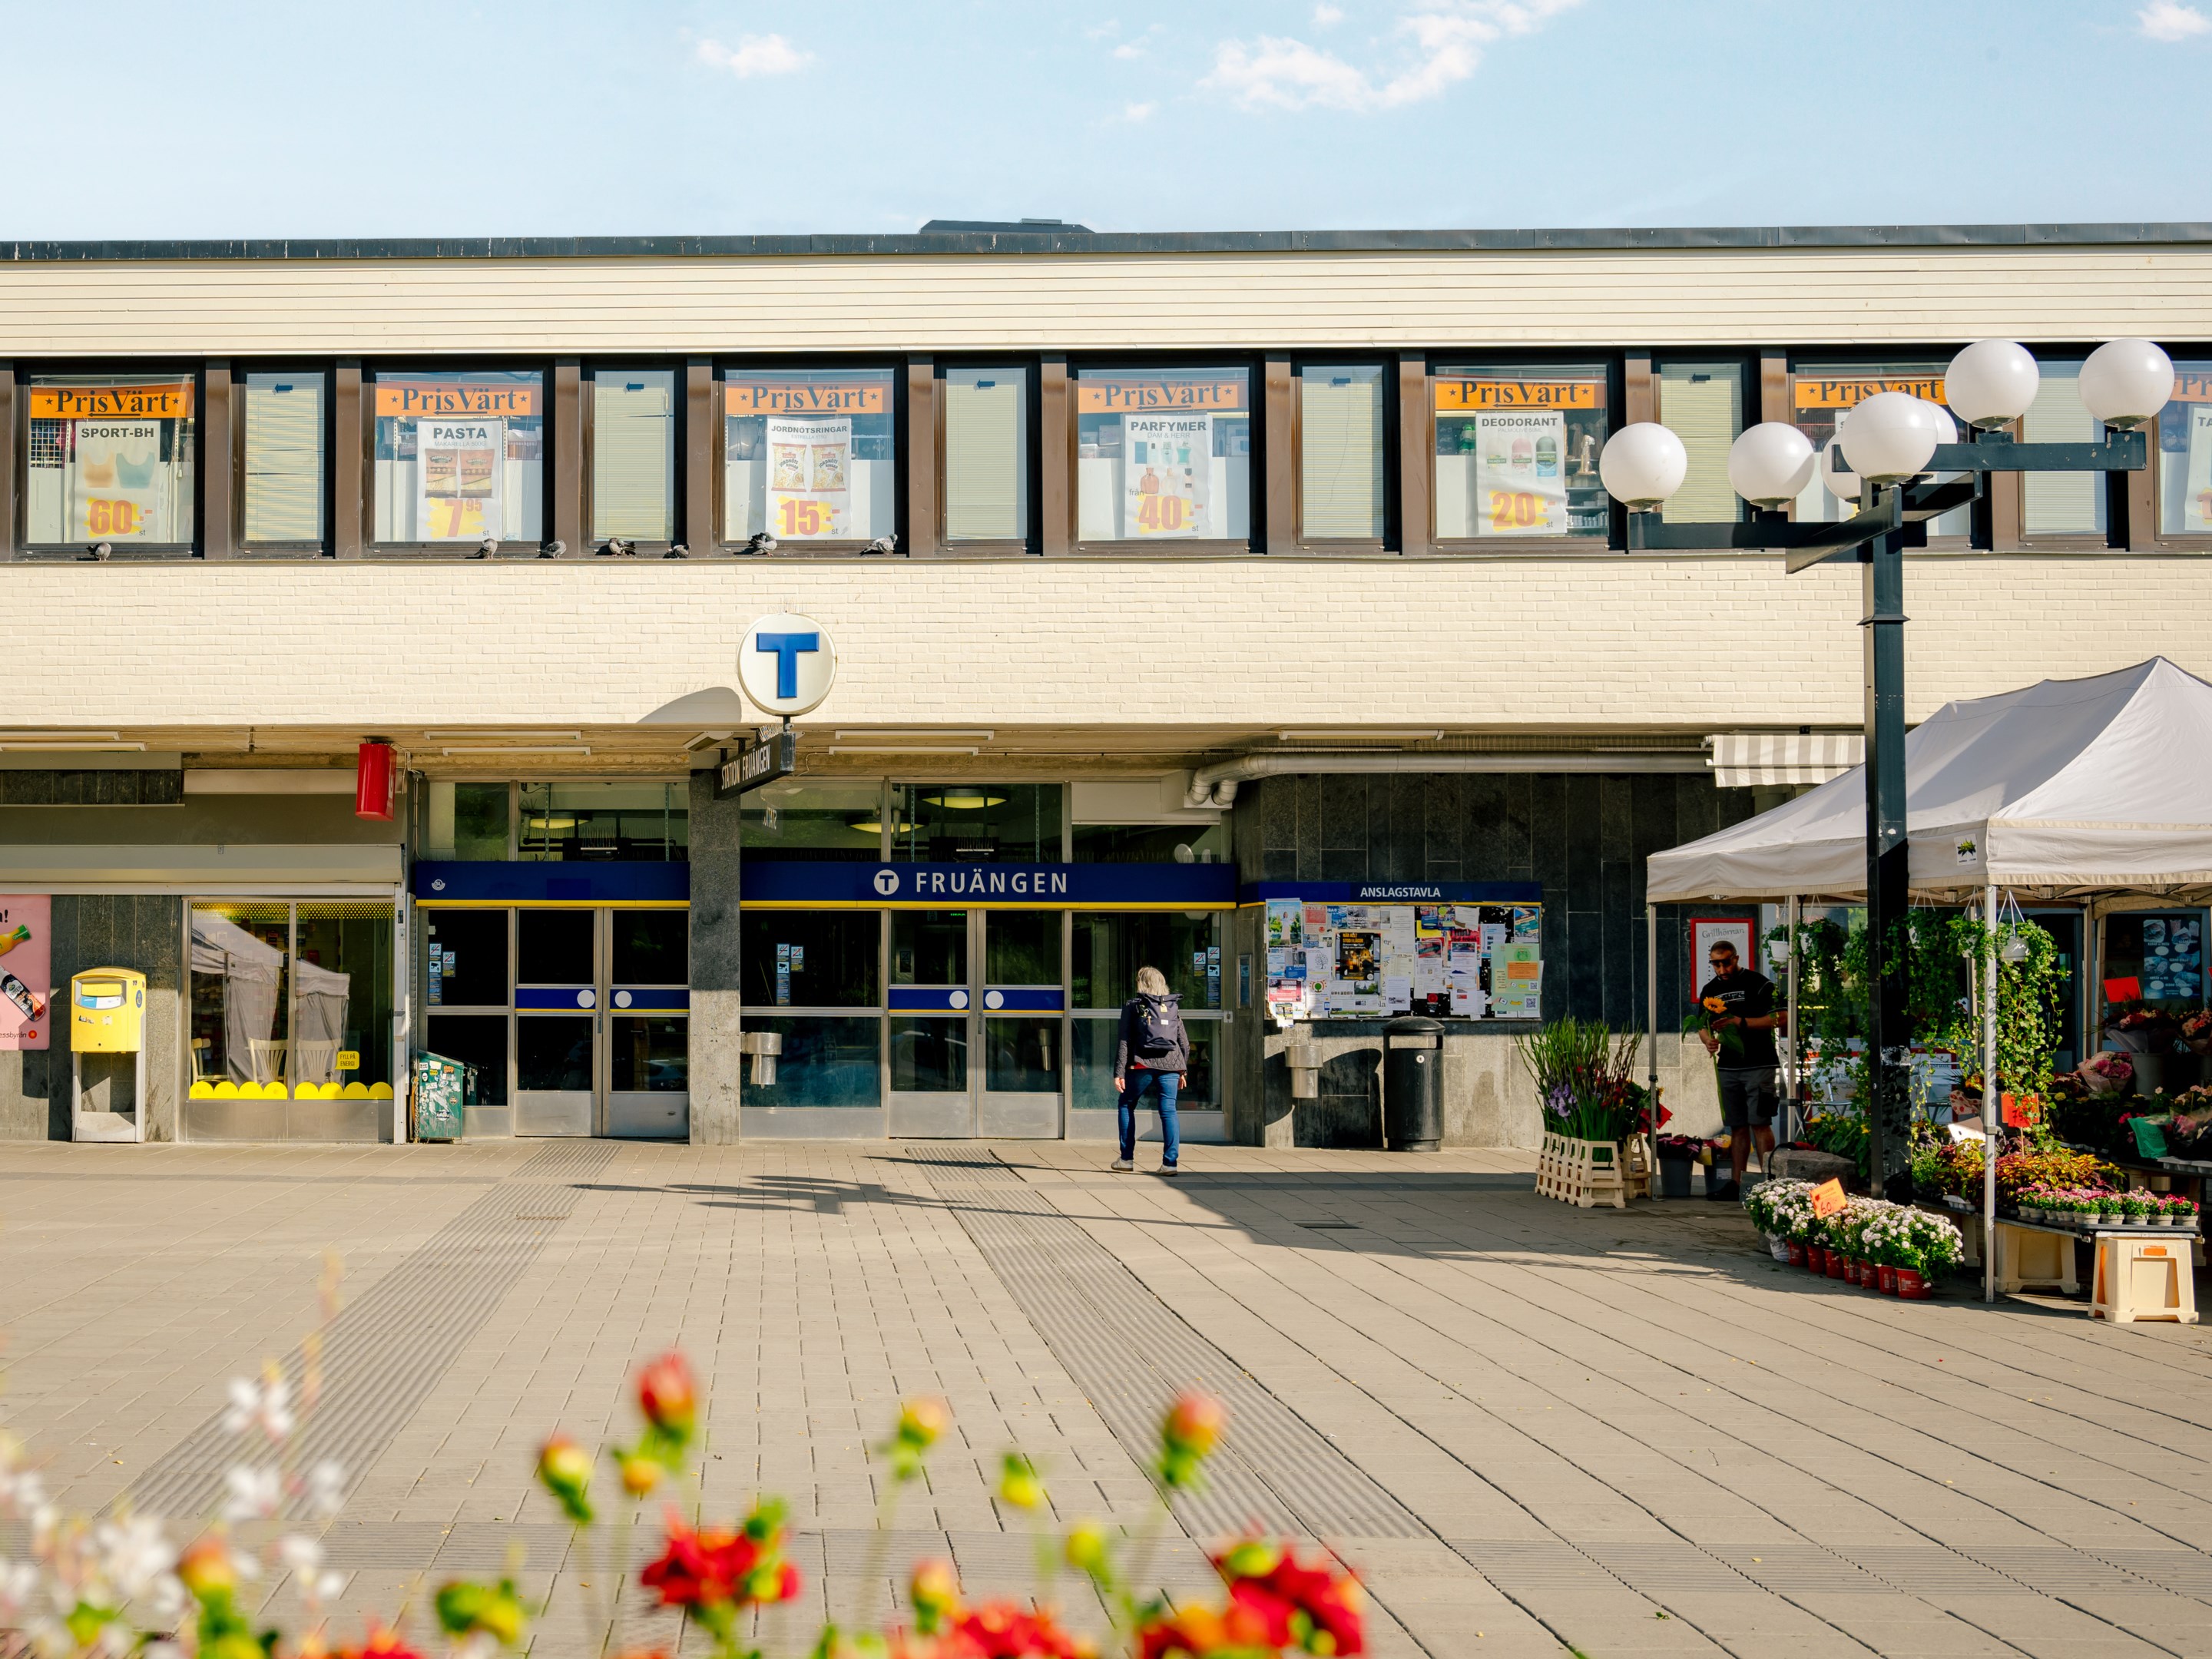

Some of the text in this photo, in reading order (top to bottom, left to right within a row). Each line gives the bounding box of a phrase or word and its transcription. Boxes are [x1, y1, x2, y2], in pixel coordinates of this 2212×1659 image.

[55, 390, 170, 412] PrisVärt
[401, 388, 517, 410] PrisVärt
[750, 386, 867, 409] PrisVärt
[1104, 381, 1221, 406] PrisVärt
[81, 427, 154, 439] SPORT-BH
[433, 427, 488, 439] PASTA
[771, 426, 847, 434] JORDNÖTSRINGAR
[1131, 421, 1207, 431] PARFYMER
[1482, 418, 1558, 427] DEODORANT
[445, 499, 464, 537] 7
[757, 631, 820, 699] T
[721, 744, 770, 790] STATION FRUÄNGEN
[879, 868, 1067, 893] T FRUÄNGEN
[1359, 887, 1442, 898] ANSLAGSTAVLA
